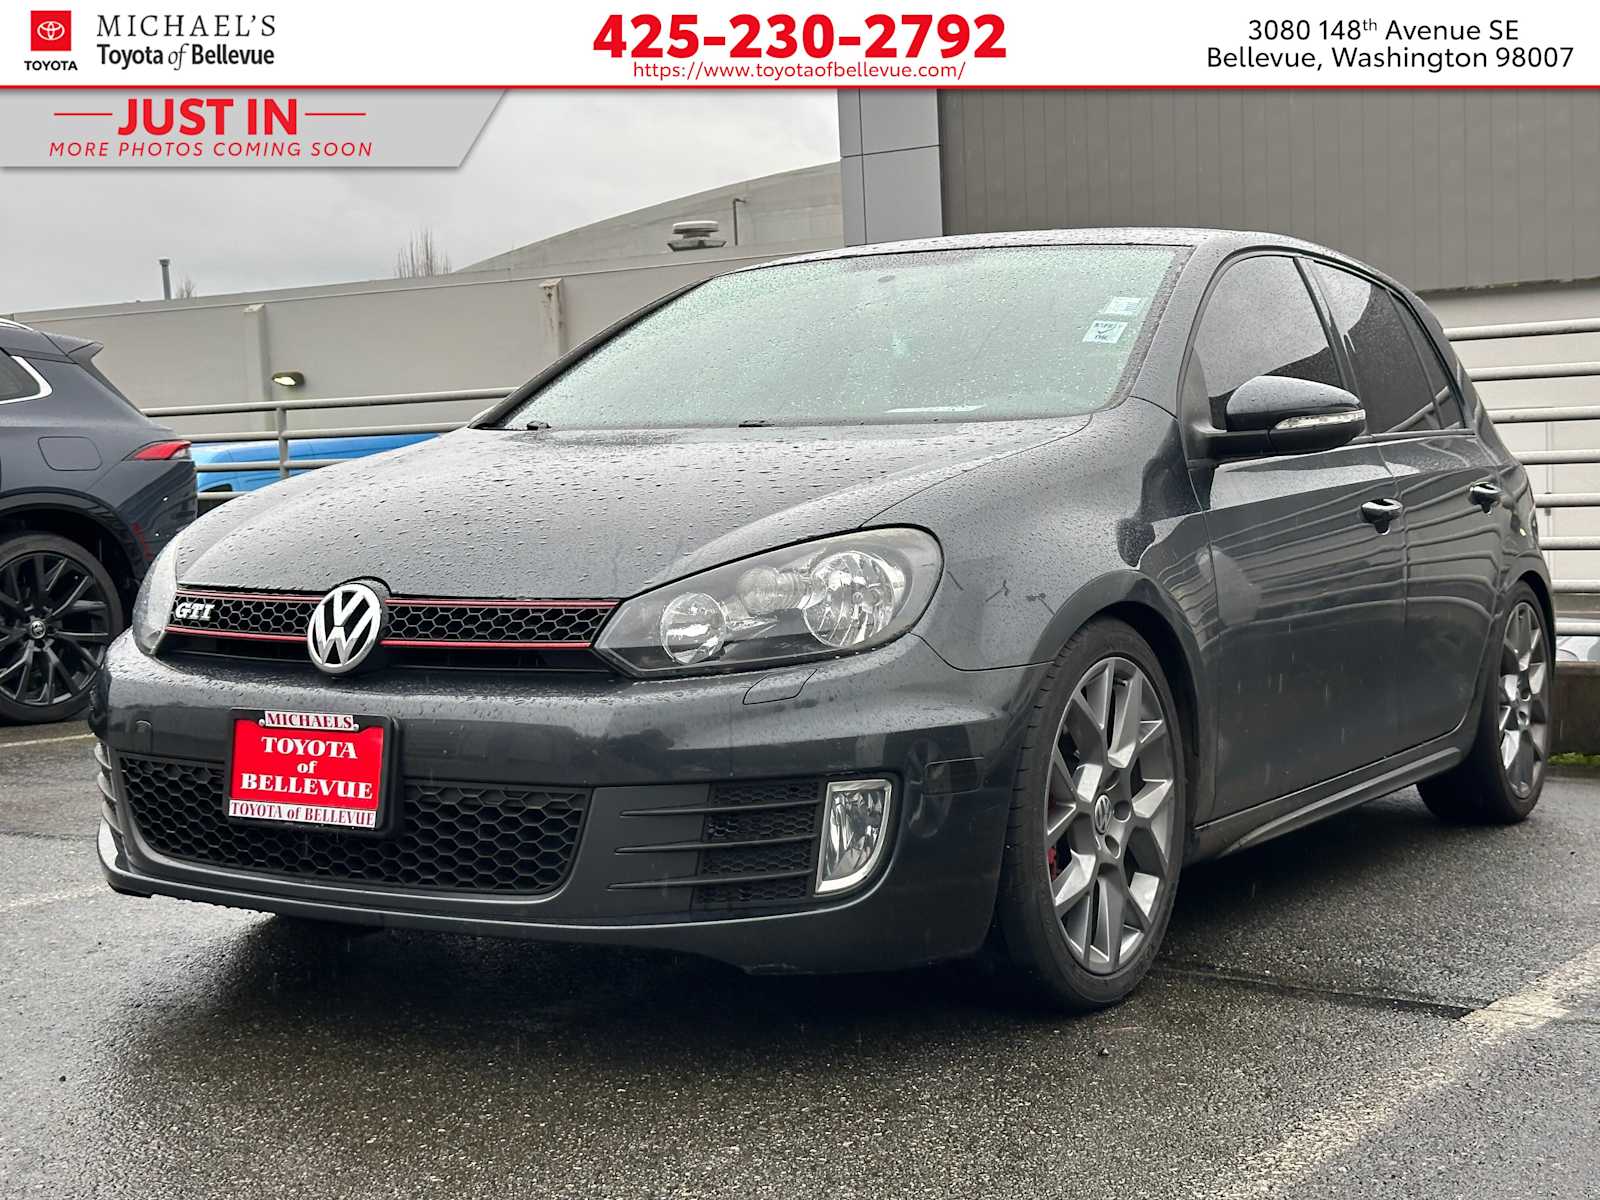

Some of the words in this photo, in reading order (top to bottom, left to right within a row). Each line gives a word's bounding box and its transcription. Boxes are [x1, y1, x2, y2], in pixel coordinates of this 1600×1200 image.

[175, 602, 215, 621] GTI
[265, 713, 353, 730] MICHAELS
[261, 736, 358, 759] TOYOTA
[297, 760, 318, 774] of
[240, 773, 373, 800] BELLEVUE
[231, 802, 283, 819] TOYOTA
[287, 807, 301, 820] of
[305, 808, 375, 826] BELLEVUE
